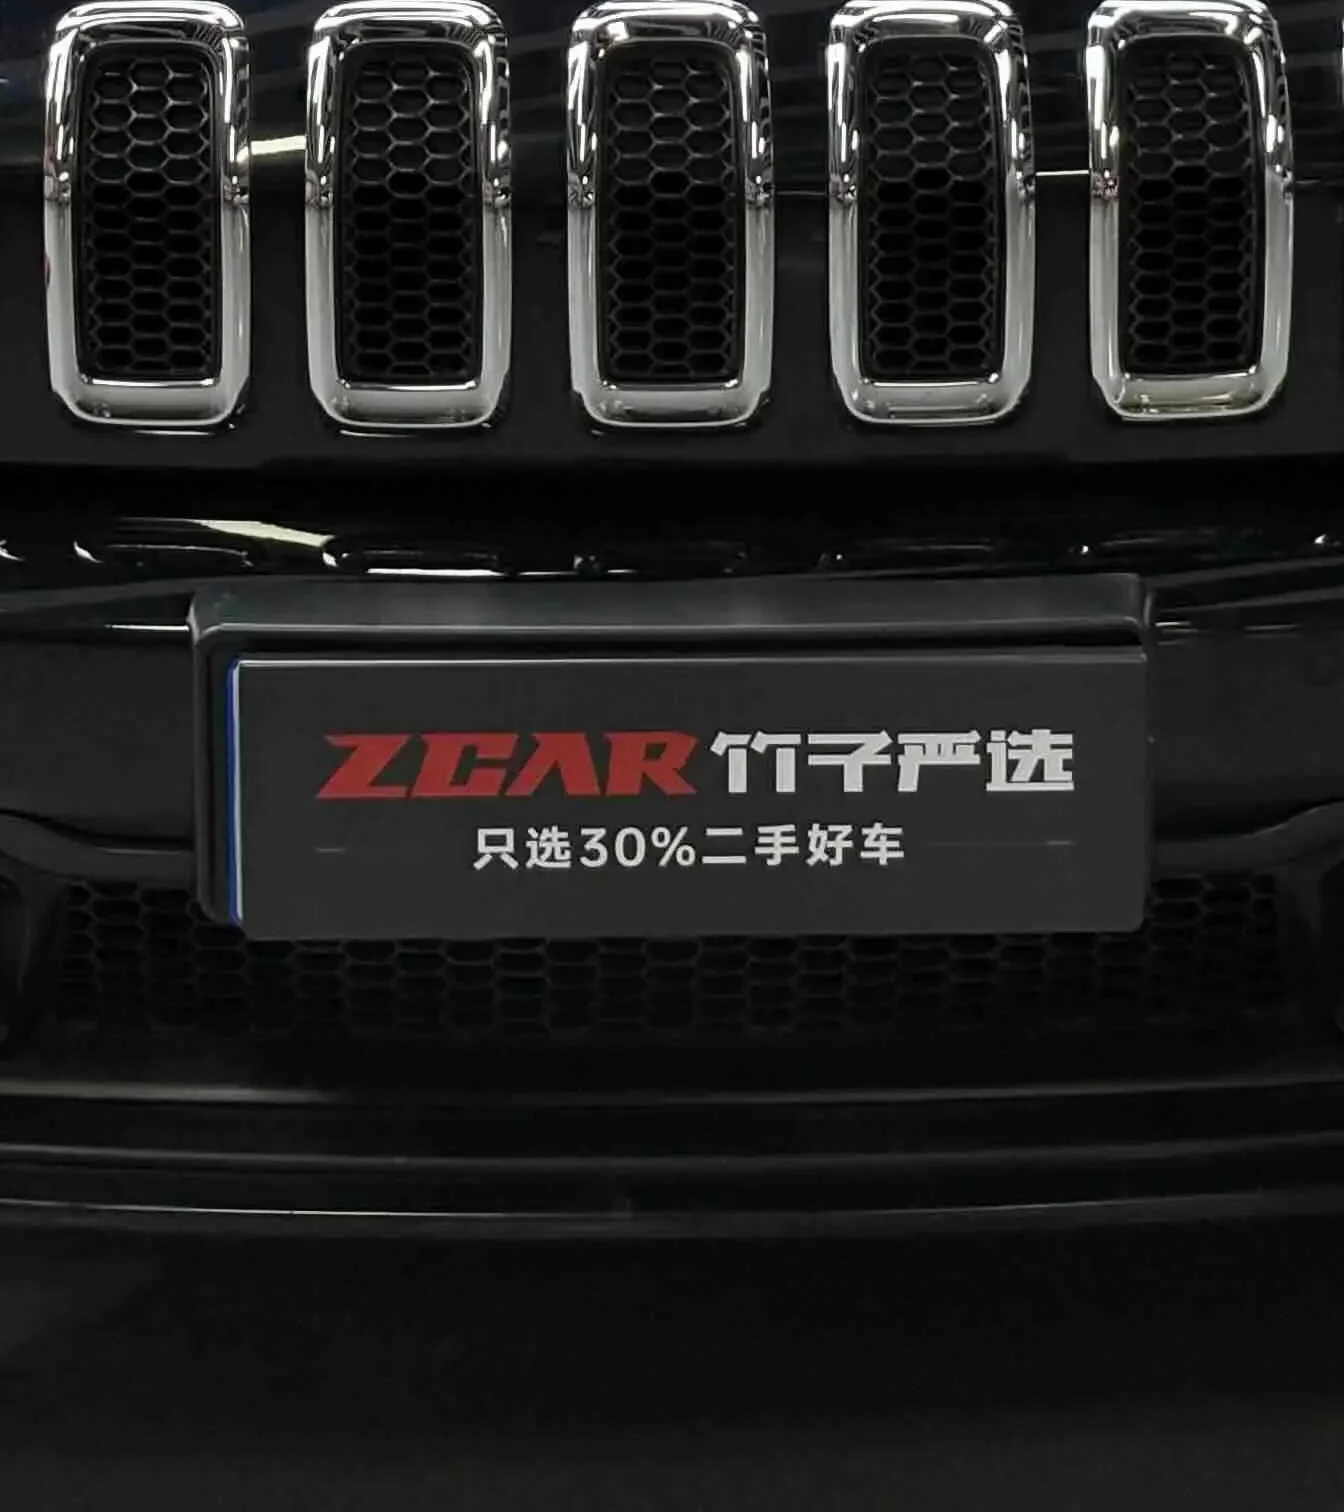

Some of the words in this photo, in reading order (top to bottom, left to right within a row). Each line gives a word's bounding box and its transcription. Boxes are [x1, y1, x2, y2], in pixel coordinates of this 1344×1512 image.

[315, 730, 700, 798] ZCAR
[709, 729, 1076, 794] 竹子严选
[472, 822, 906, 871] 只选30%二手好车
